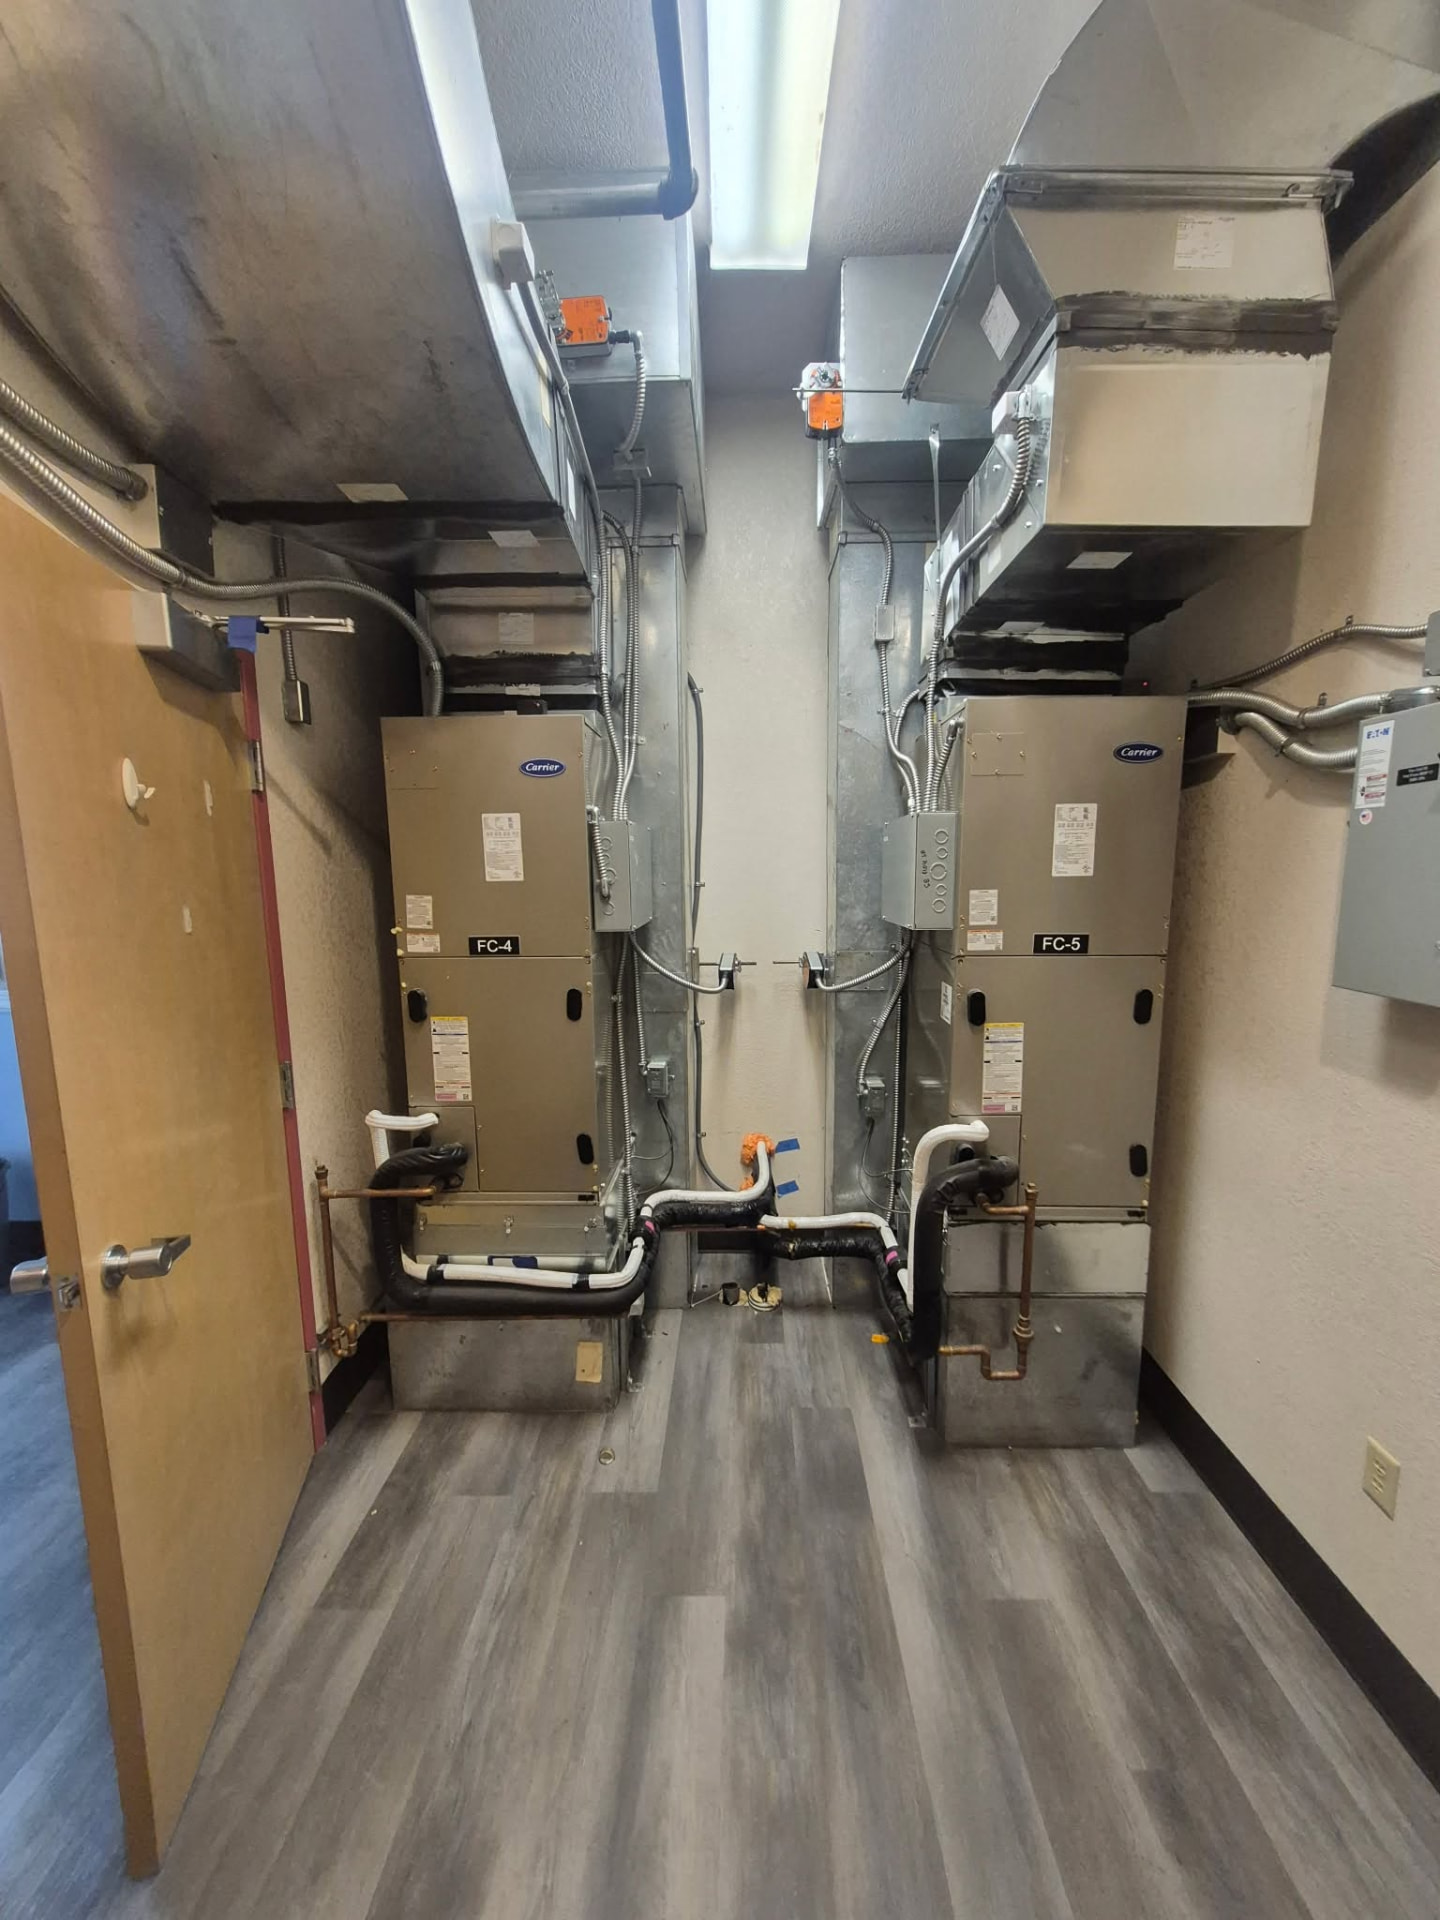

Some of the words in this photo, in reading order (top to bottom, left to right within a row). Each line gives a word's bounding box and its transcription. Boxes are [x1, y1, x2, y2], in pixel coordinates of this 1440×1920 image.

[1121, 748, 1158, 757] Carrier
[525, 762, 560, 772] Carrier
[477, 939, 513, 953] FC-4
[1042, 937, 1081, 951] FC-5
